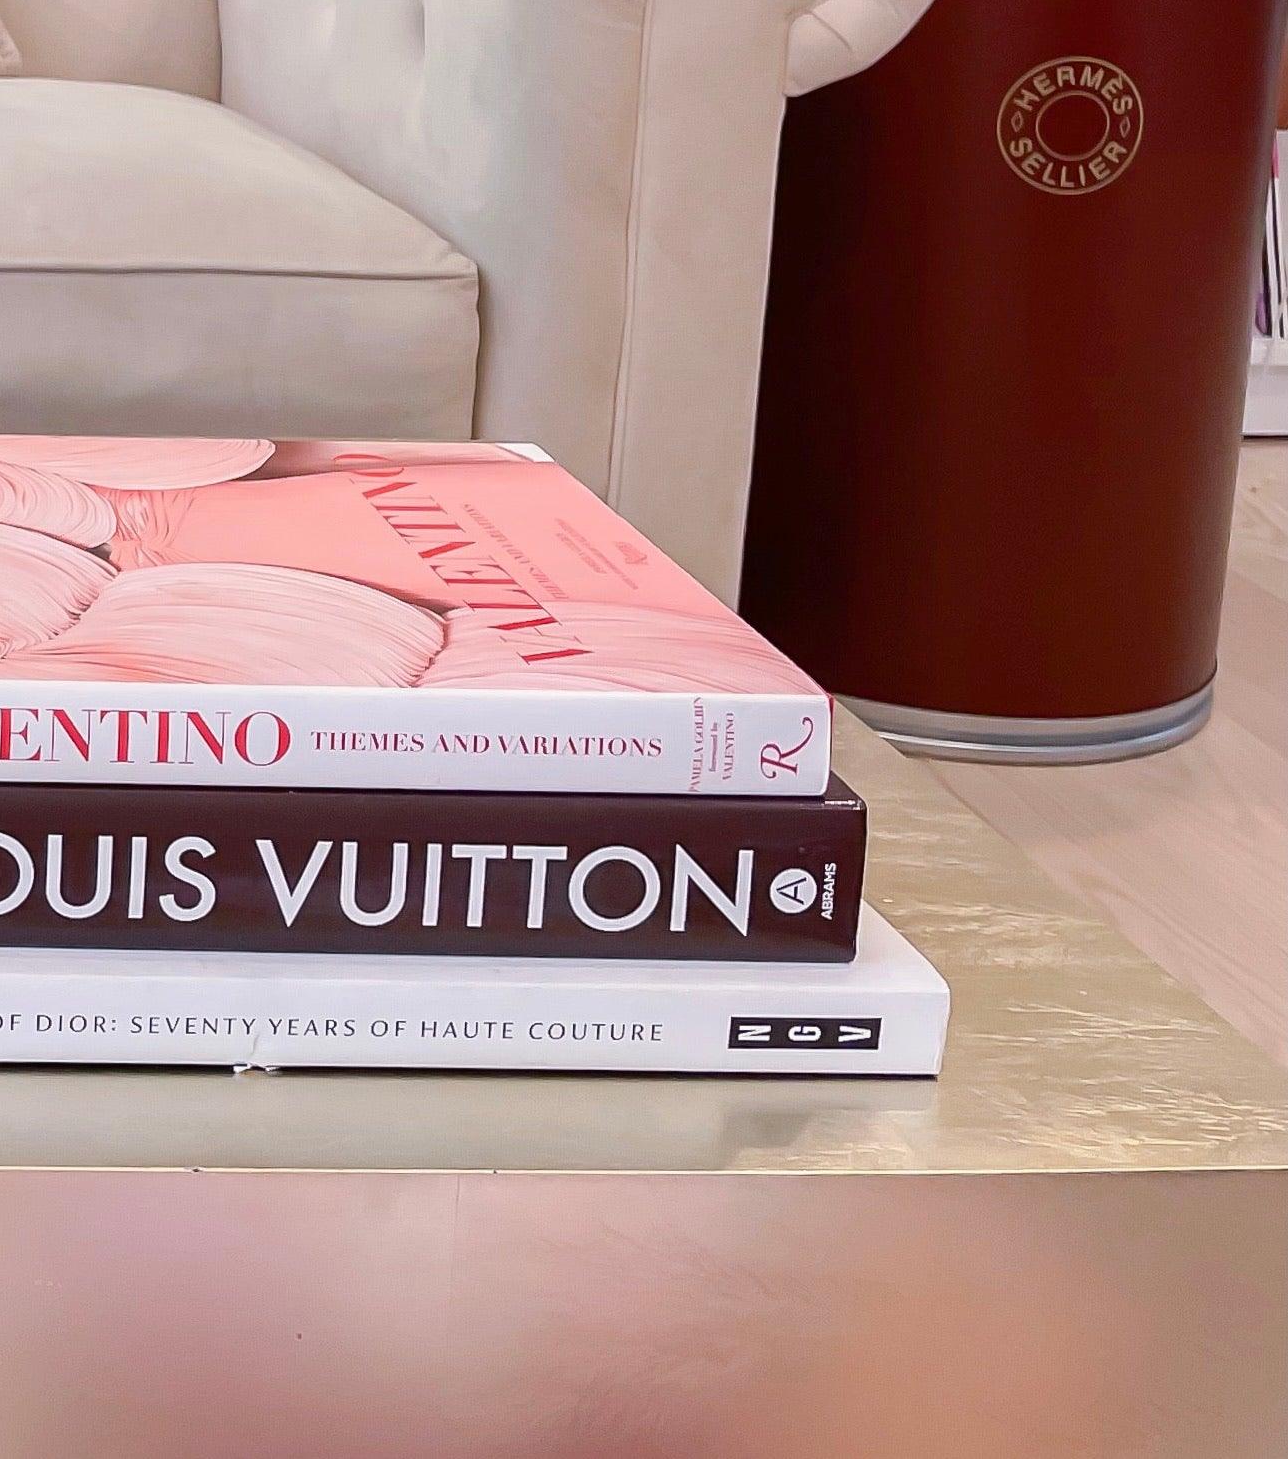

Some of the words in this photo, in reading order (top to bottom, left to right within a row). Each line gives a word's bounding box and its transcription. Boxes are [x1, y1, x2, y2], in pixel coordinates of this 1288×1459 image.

[1010, 136, 1127, 188] SELLIER
[333, 453, 594, 665] VALENTINO
[311, 731, 425, 753] THEMES
[432, 733, 491, 755] AND
[498, 735, 663, 758] VARIATIONS
[723, 712, 735, 780] VALENTINO
[760, 716, 814, 779] R
[256, 839, 755, 937] VUITTON
[776, 877, 807, 905] A
[821, 862, 837, 920] ABRAMS
[36, 1014, 118, 1034] DIOR:
[130, 1015, 255, 1036] SEVENTY
[269, 1017, 356, 1037] YEARS
[371, 1019, 406, 1039] OF
[421, 1020, 514, 1040] HAUTE
[528, 1021, 664, 1042] COUTURE
